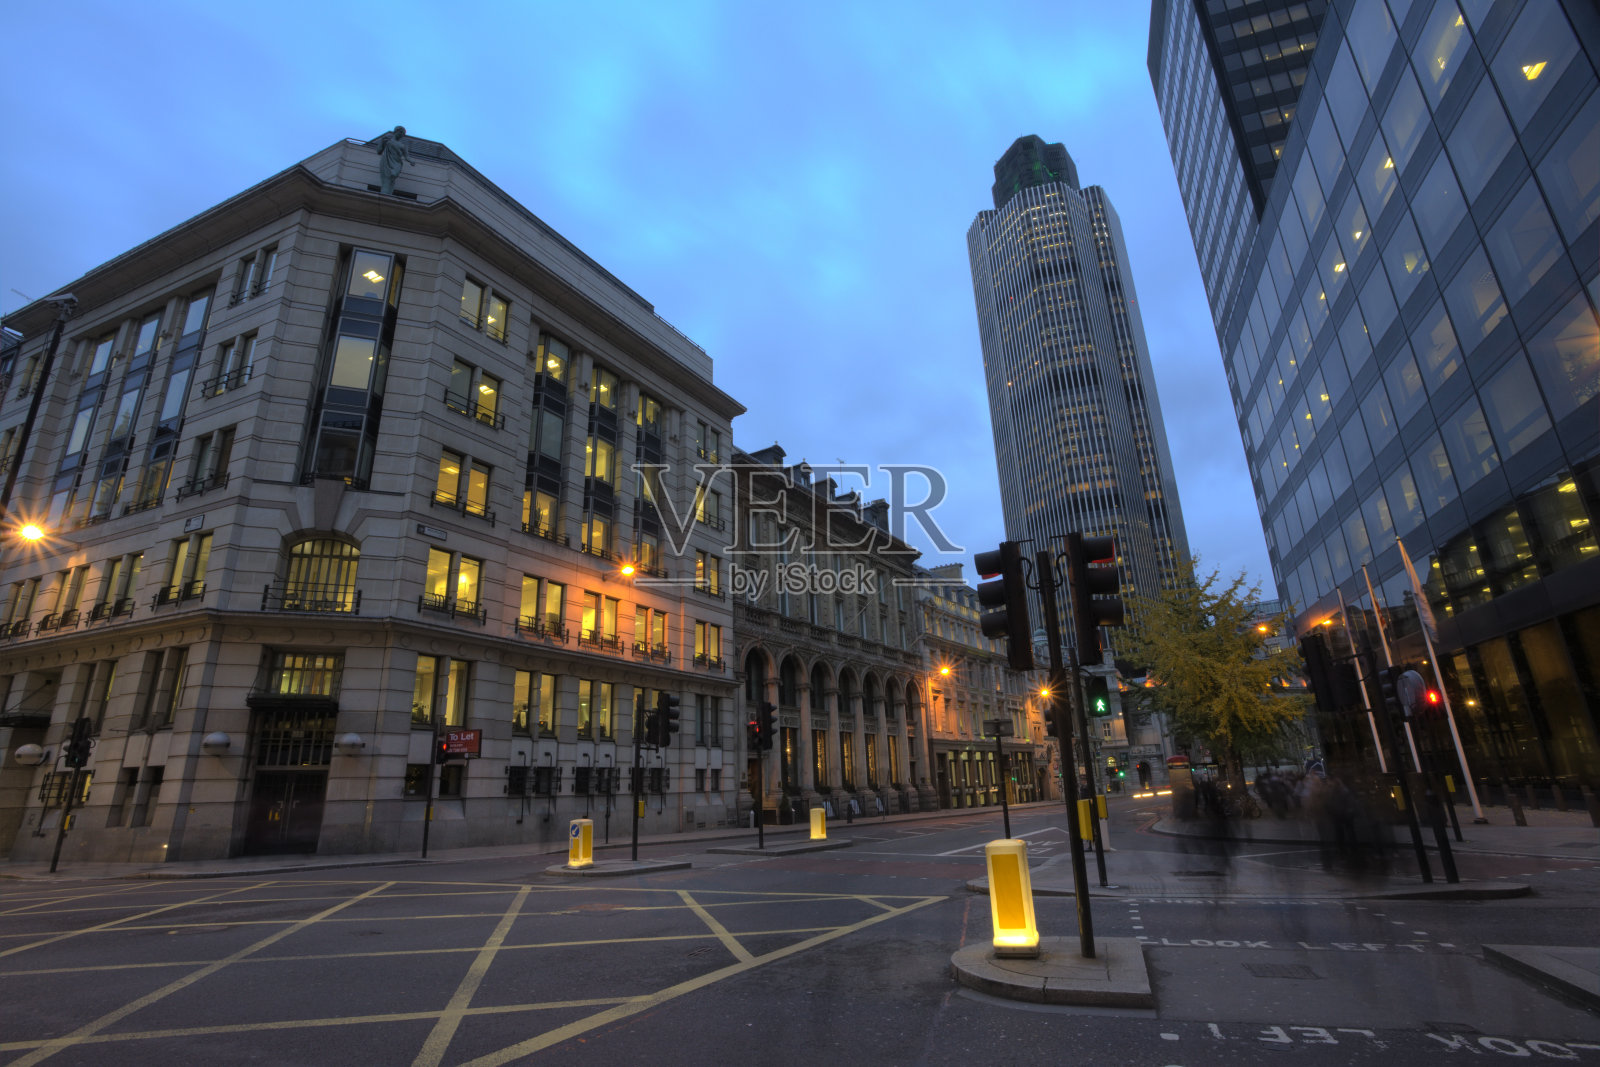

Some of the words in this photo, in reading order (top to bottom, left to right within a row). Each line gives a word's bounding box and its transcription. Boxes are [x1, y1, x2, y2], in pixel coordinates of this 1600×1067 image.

[449, 733, 458, 741] To
[460, 732, 474, 741] Let
[1161, 938, 1273, 949] LOOK
[1297, 941, 1425, 953] LEFT
